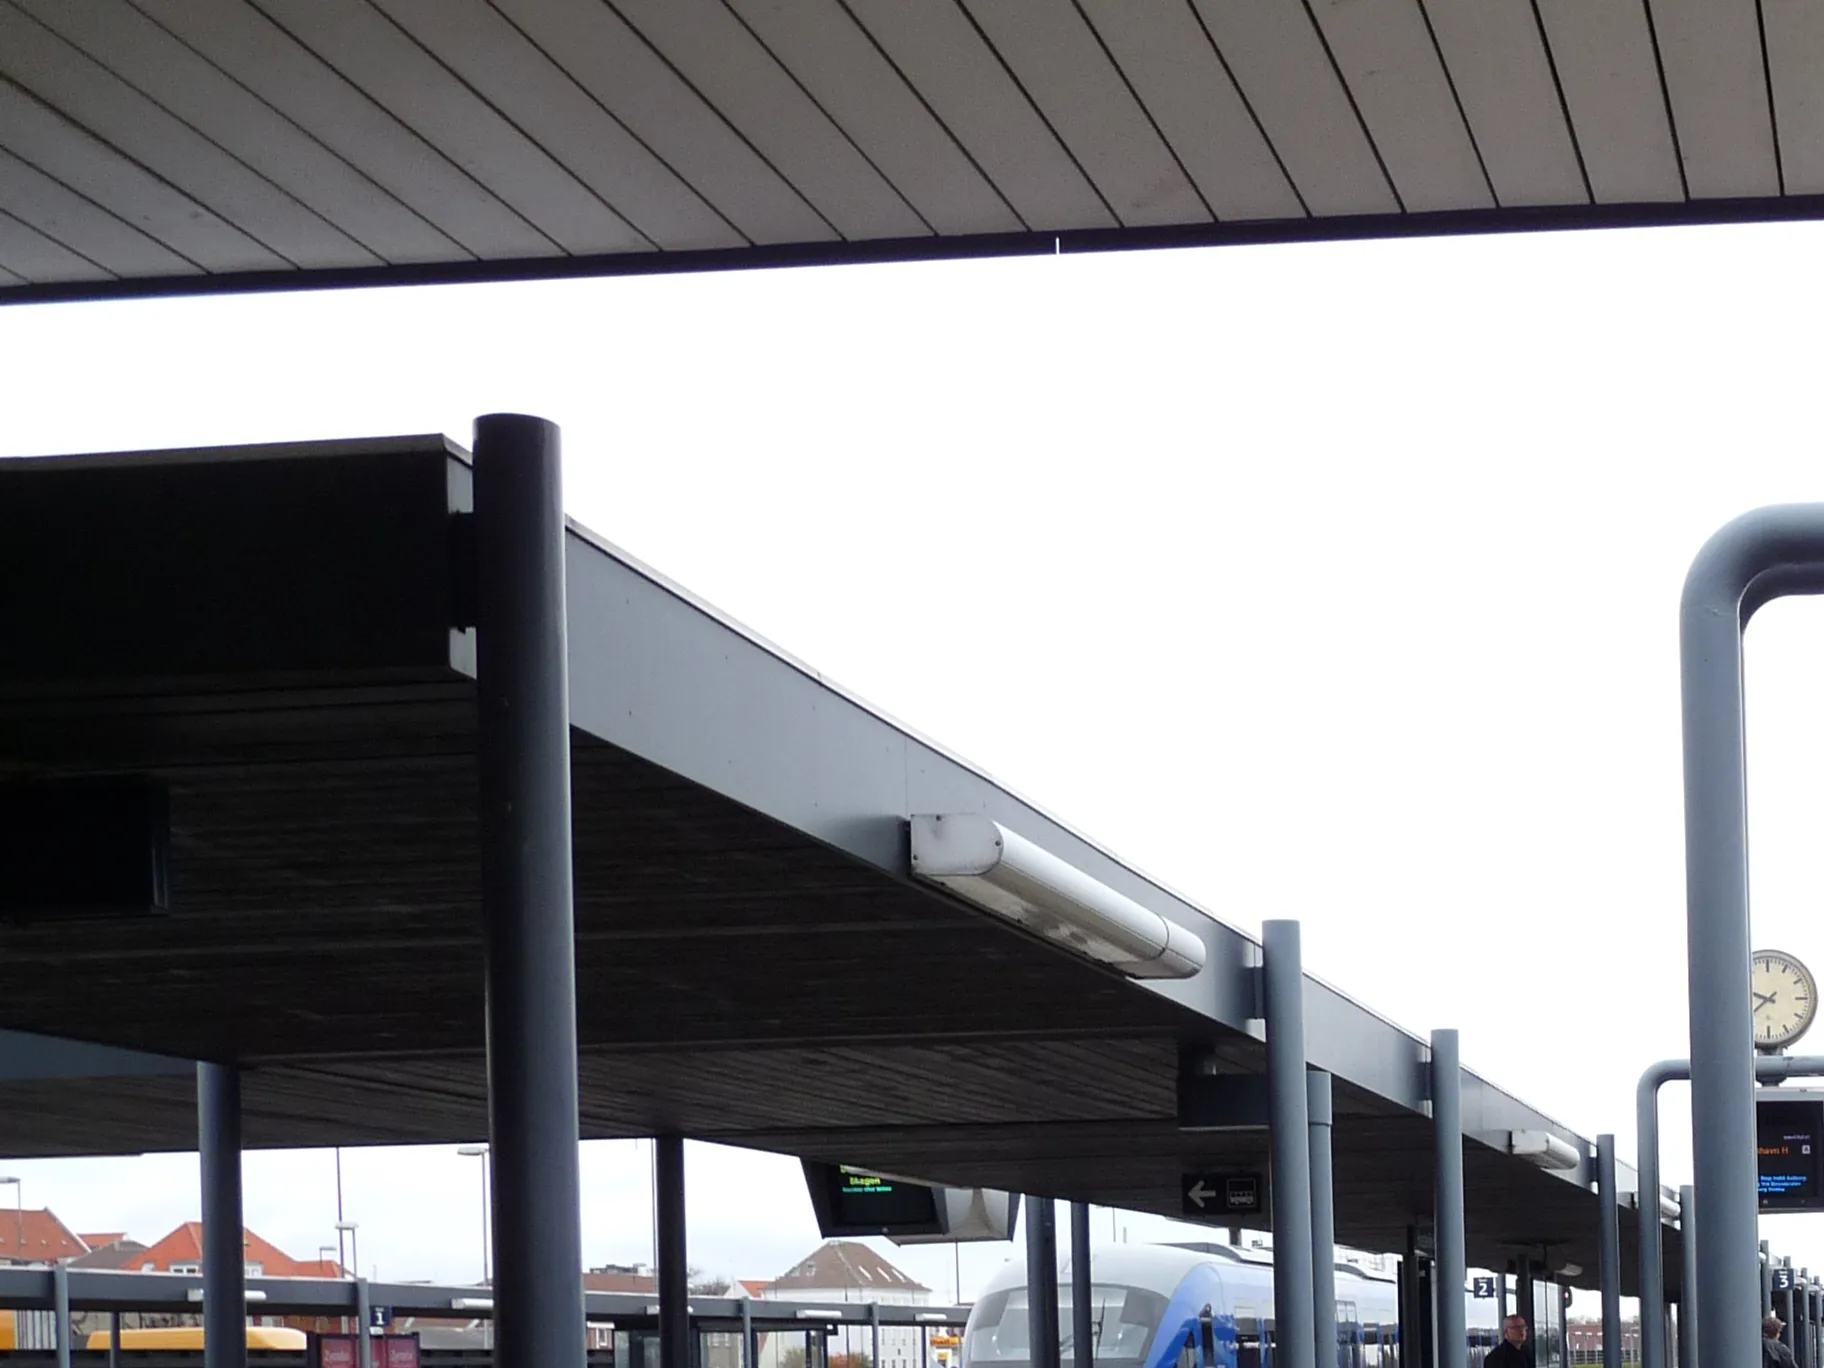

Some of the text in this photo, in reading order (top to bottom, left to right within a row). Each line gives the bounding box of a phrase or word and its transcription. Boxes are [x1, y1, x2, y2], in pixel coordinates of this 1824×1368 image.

[1779, 1275, 1789, 1288] 3
[1478, 1283, 1489, 1296] 2
[375, 1312, 384, 1325] 1
